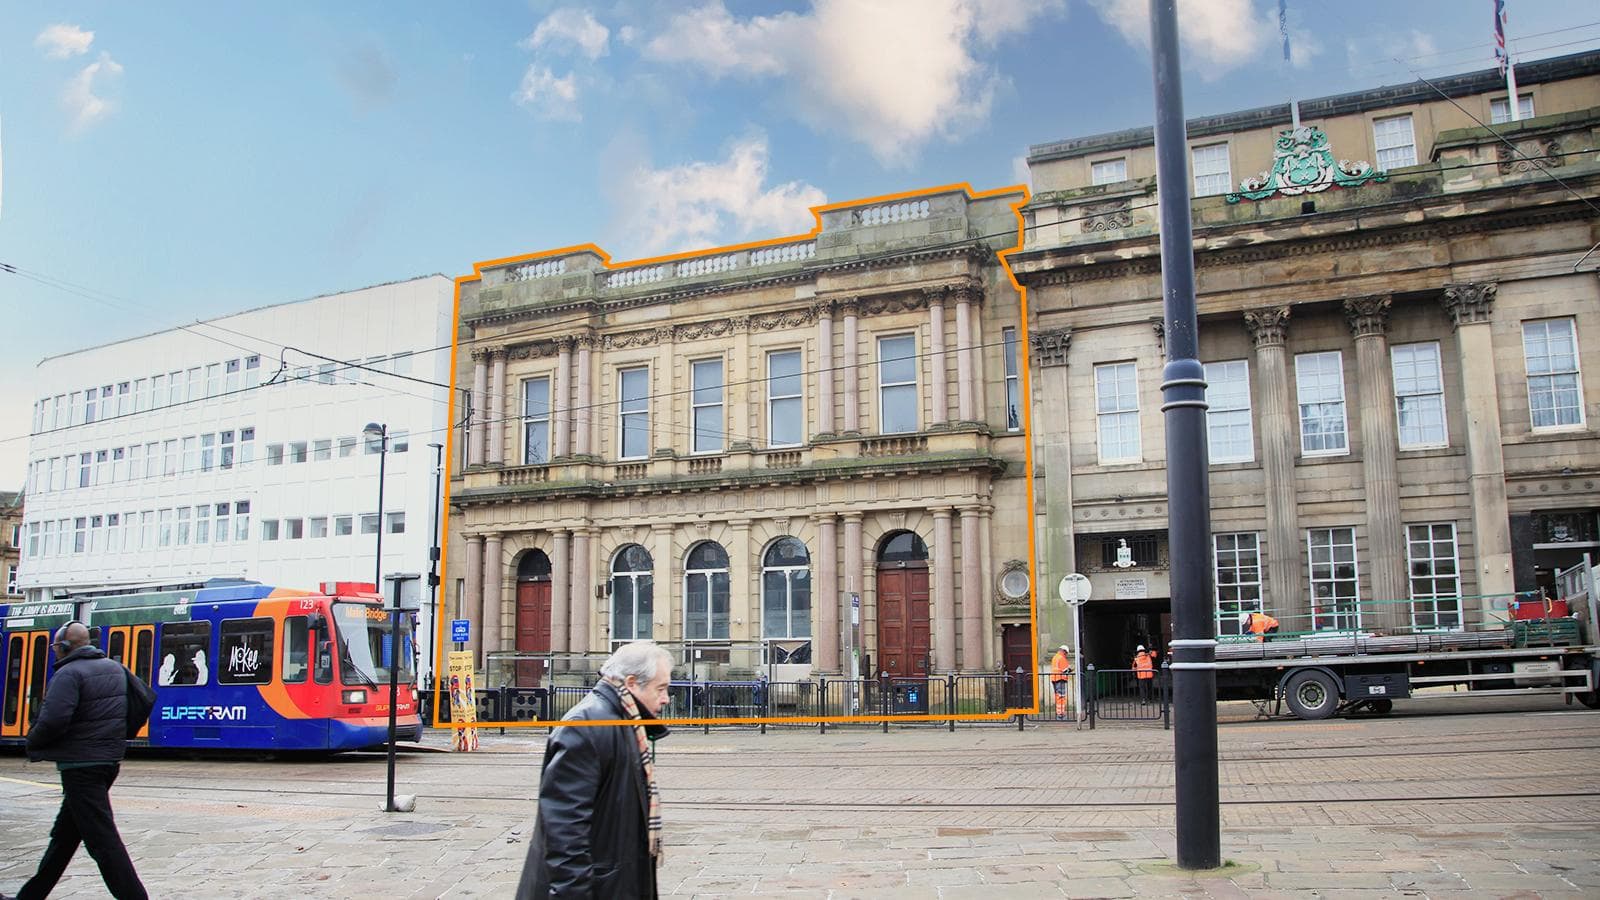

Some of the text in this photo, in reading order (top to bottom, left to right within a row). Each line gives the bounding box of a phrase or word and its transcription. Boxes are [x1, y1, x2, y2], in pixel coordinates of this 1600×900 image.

[300, 599, 314, 609] 123
[11, 606, 22, 616] THE
[365, 607, 387, 622] Bridge
[161, 706, 247, 720] SUPERTRAM
